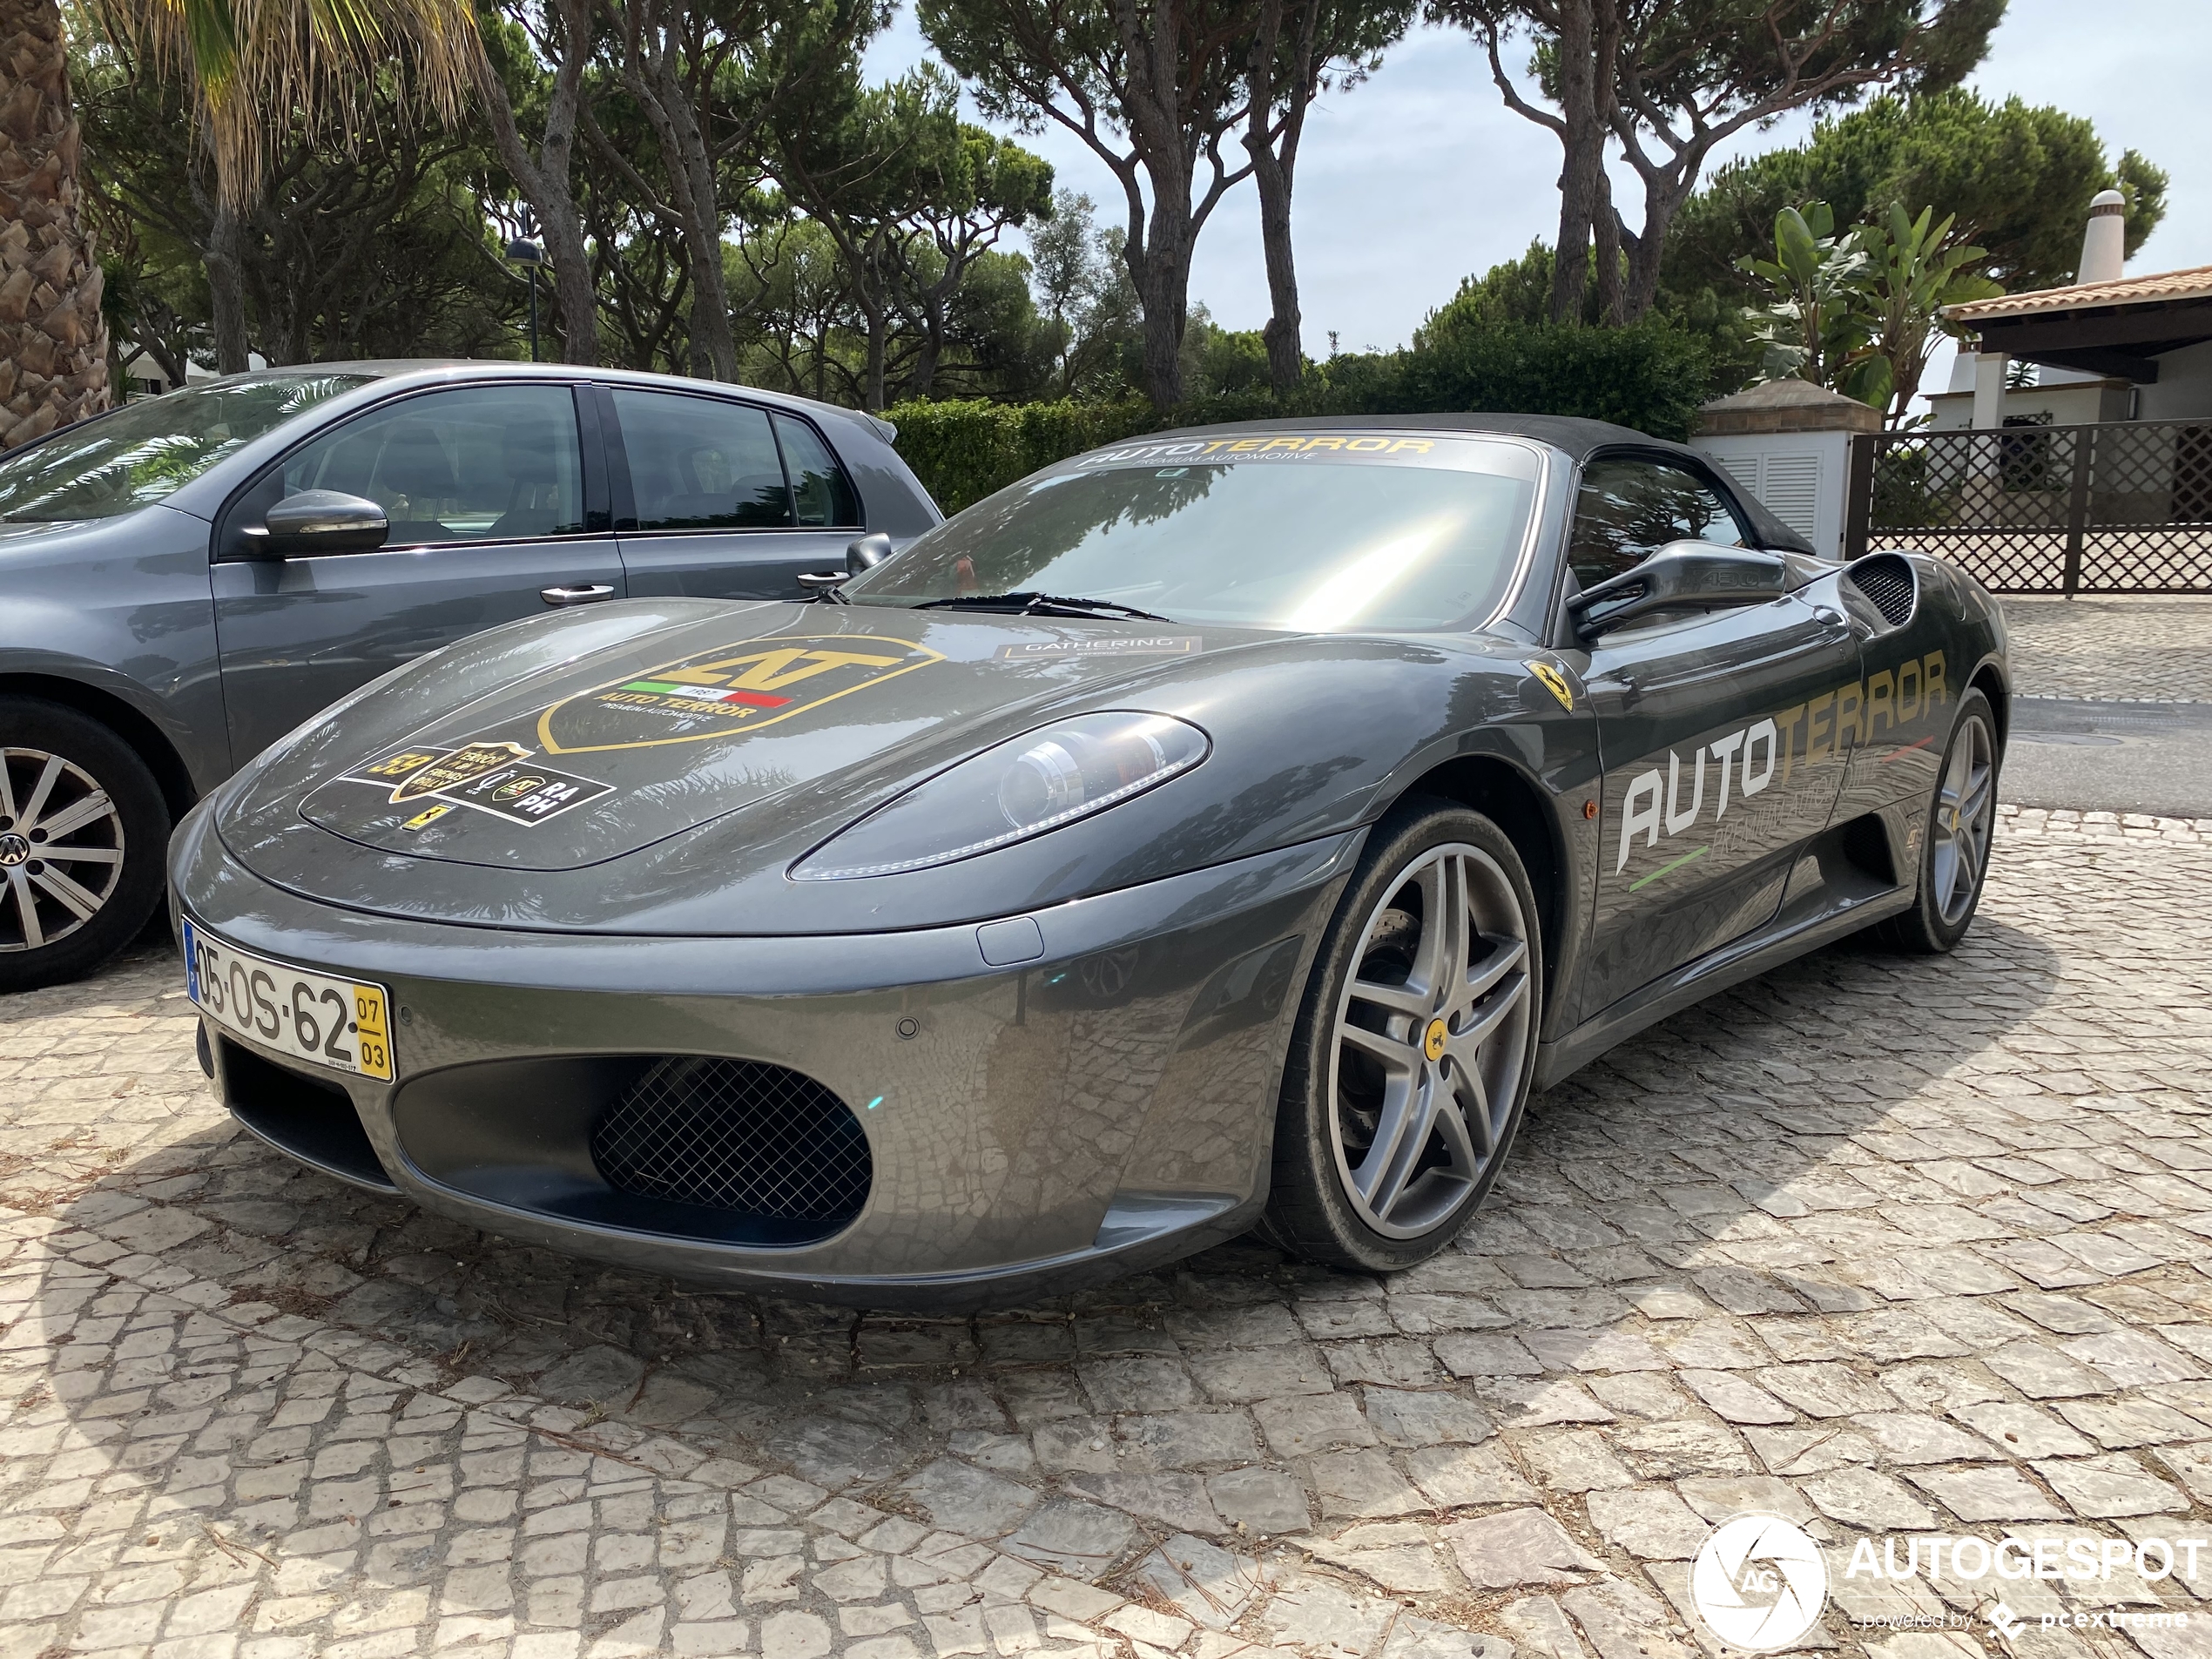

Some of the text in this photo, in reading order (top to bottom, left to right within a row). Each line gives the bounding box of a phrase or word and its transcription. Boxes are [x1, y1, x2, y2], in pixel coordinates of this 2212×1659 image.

[1075, 437, 1435, 468] AUTOTERROR
[1132, 452, 1318, 466] PREMIUM AUTOMOTIVE
[1025, 638, 1173, 651] GATHERING
[687, 688, 717, 697] 1987
[593, 691, 758, 718] AUTO TERROR
[598, 703, 716, 722] PREMIUM AUTOMOTIVE
[367, 753, 435, 776] 59
[455, 752, 509, 765] TERROR
[1616, 649, 1946, 876] AUTOTERROR
[410, 776, 449, 788] RALLY
[538, 782, 579, 801] RA
[513, 794, 559, 815] PH
[190, 973, 195, 986] P
[196, 940, 352, 1062] 05-OS-62
[357, 997, 379, 1022] 07
[361, 1042, 385, 1069] 03
